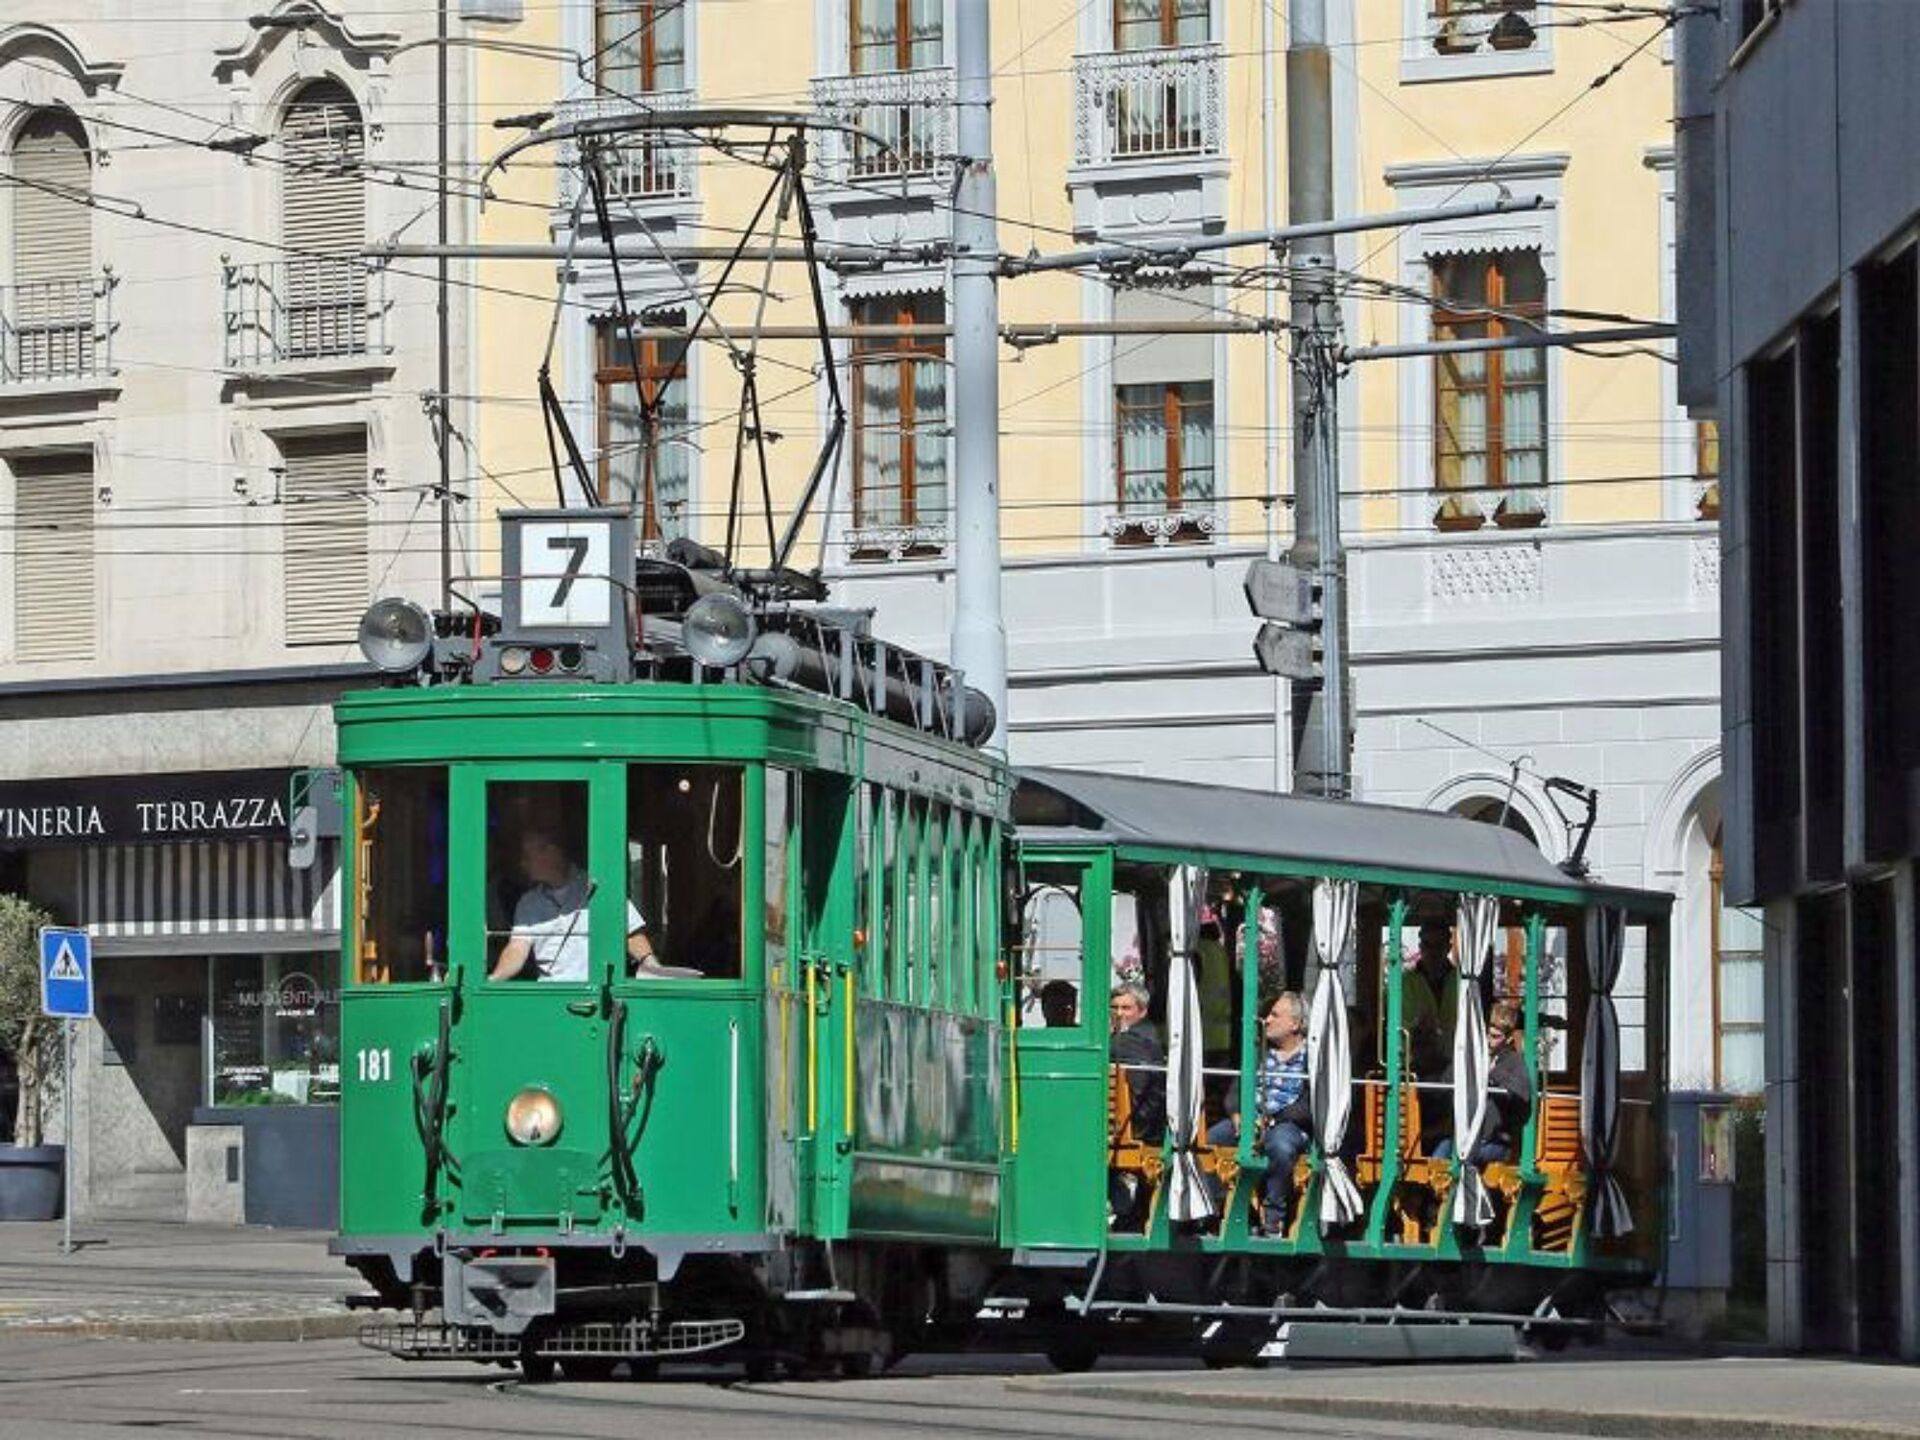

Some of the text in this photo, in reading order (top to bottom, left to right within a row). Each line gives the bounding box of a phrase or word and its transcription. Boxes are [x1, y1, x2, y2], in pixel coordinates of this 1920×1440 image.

[547, 537, 589, 608] 7
[137, 798, 286, 832] TERRAZZA
[357, 1048, 391, 1082] 181
